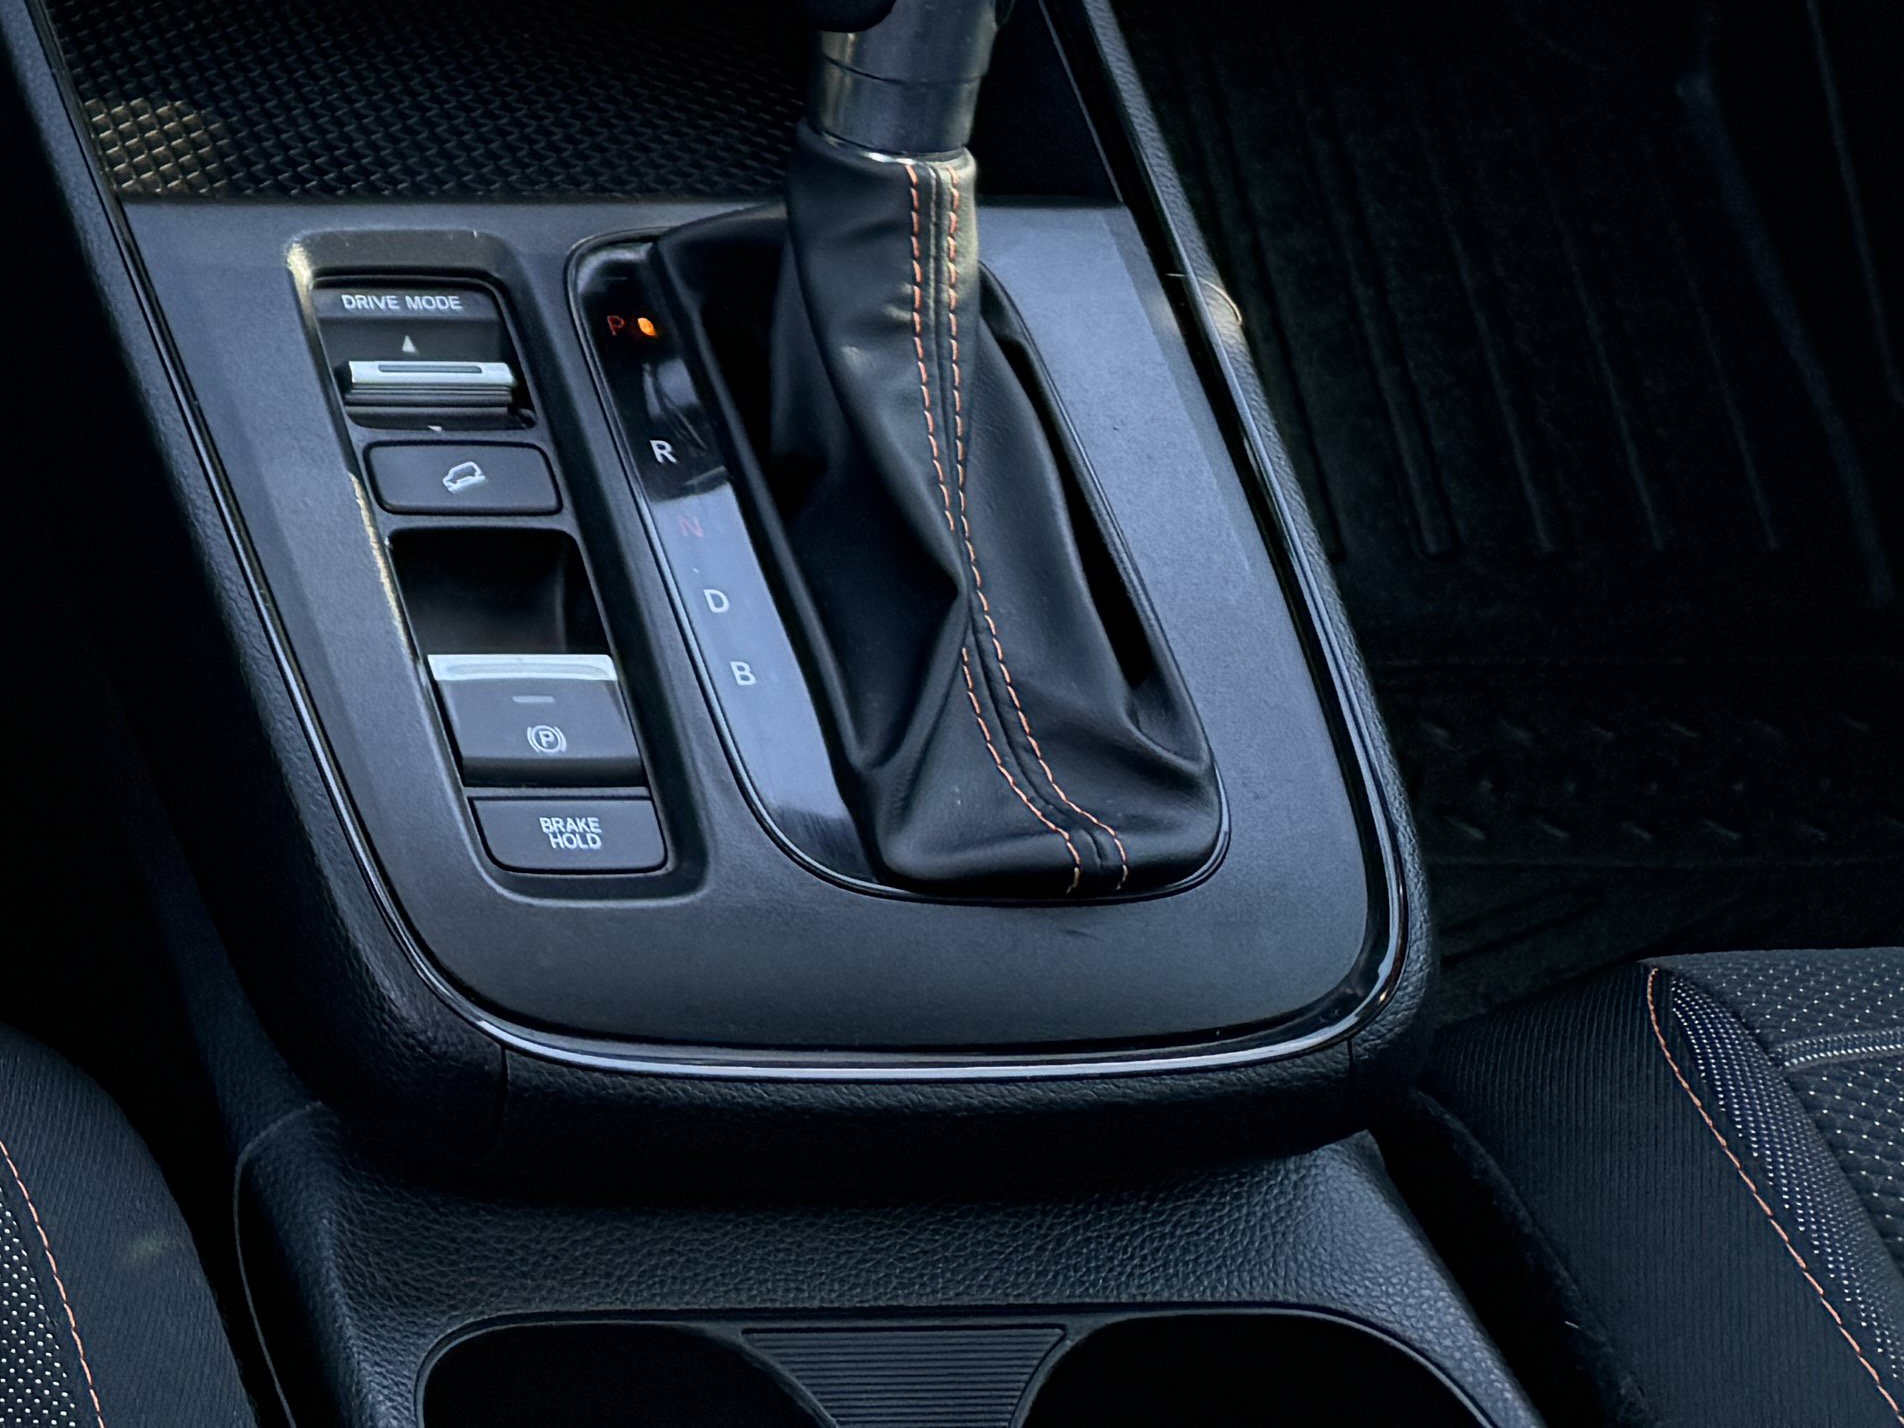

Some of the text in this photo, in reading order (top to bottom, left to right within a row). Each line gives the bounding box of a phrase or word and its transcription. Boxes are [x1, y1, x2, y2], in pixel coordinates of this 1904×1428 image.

[341, 293, 464, 311] DRIVE MODE
[606, 314, 625, 337] P
[649, 439, 678, 465] R
[677, 514, 704, 539] N
[703, 588, 730, 614] D
[729, 660, 757, 687] B
[538, 816, 603, 834] BRAKE
[548, 832, 603, 850] HOLD
